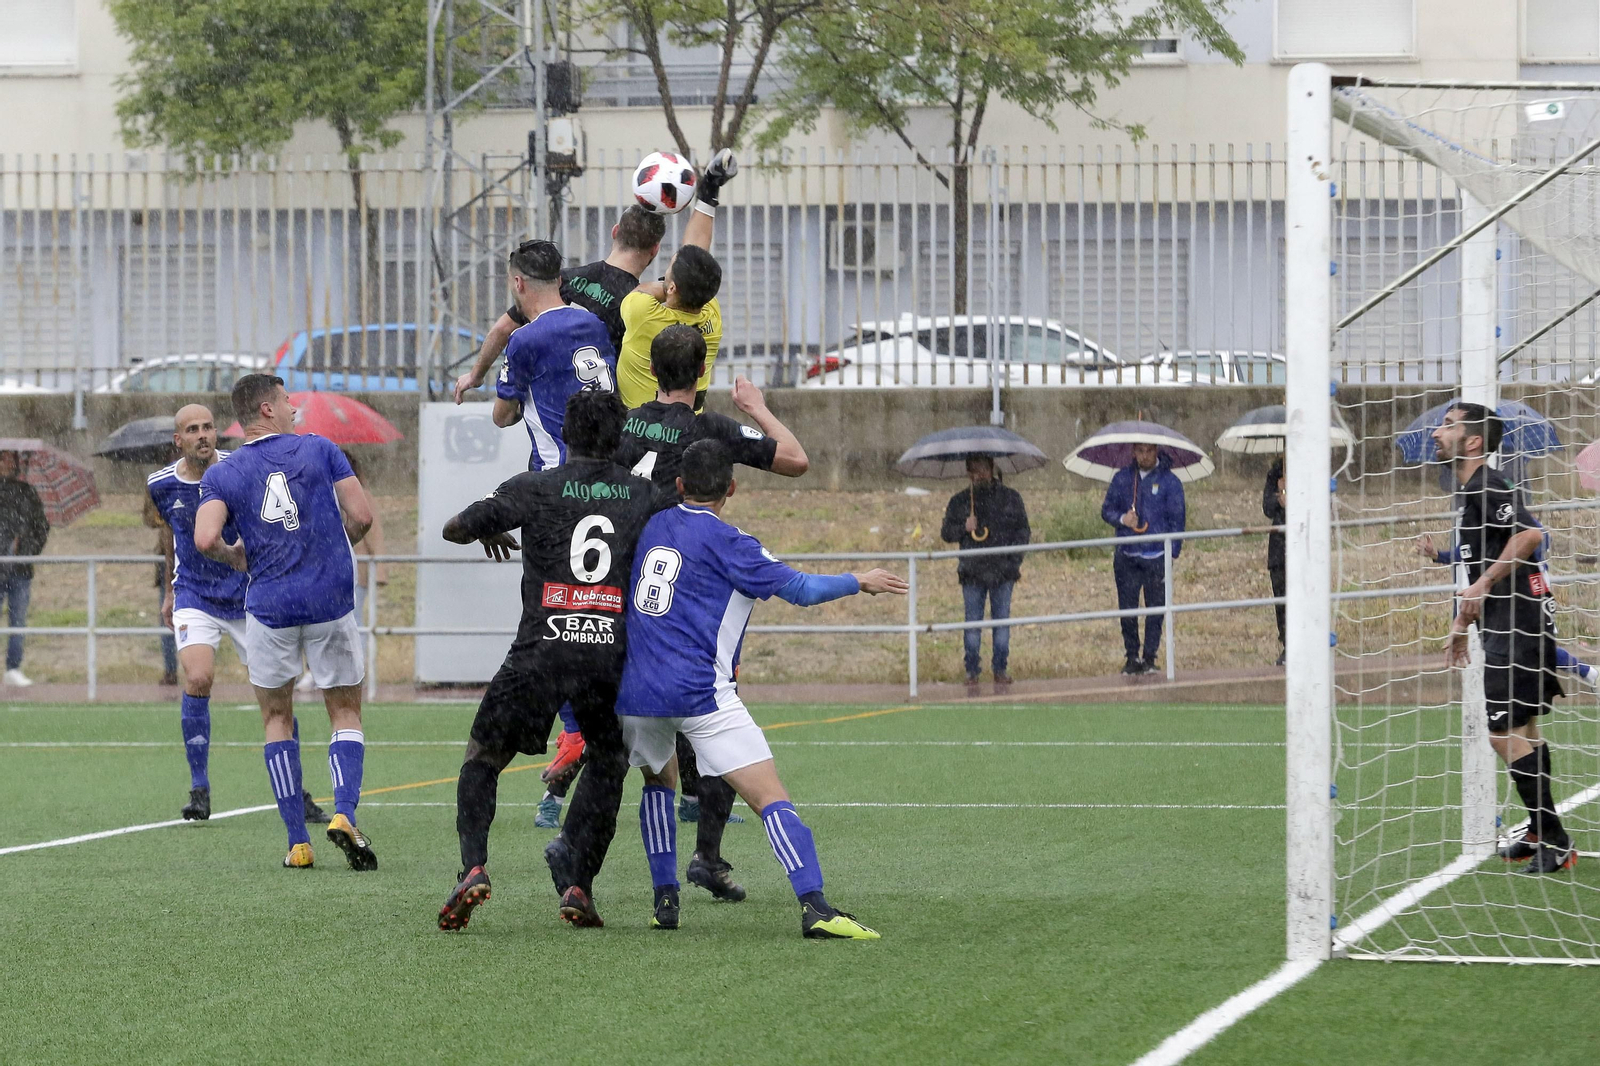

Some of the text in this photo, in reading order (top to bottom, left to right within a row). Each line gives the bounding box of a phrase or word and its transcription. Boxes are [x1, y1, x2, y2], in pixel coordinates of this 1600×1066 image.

[572, 345, 615, 393] 9
[260, 471, 300, 531] 4
[569, 514, 615, 584] 6
[572, 589, 622, 603] Nebricasa
[633, 545, 683, 617] 8
[565, 617, 614, 633] BAR
